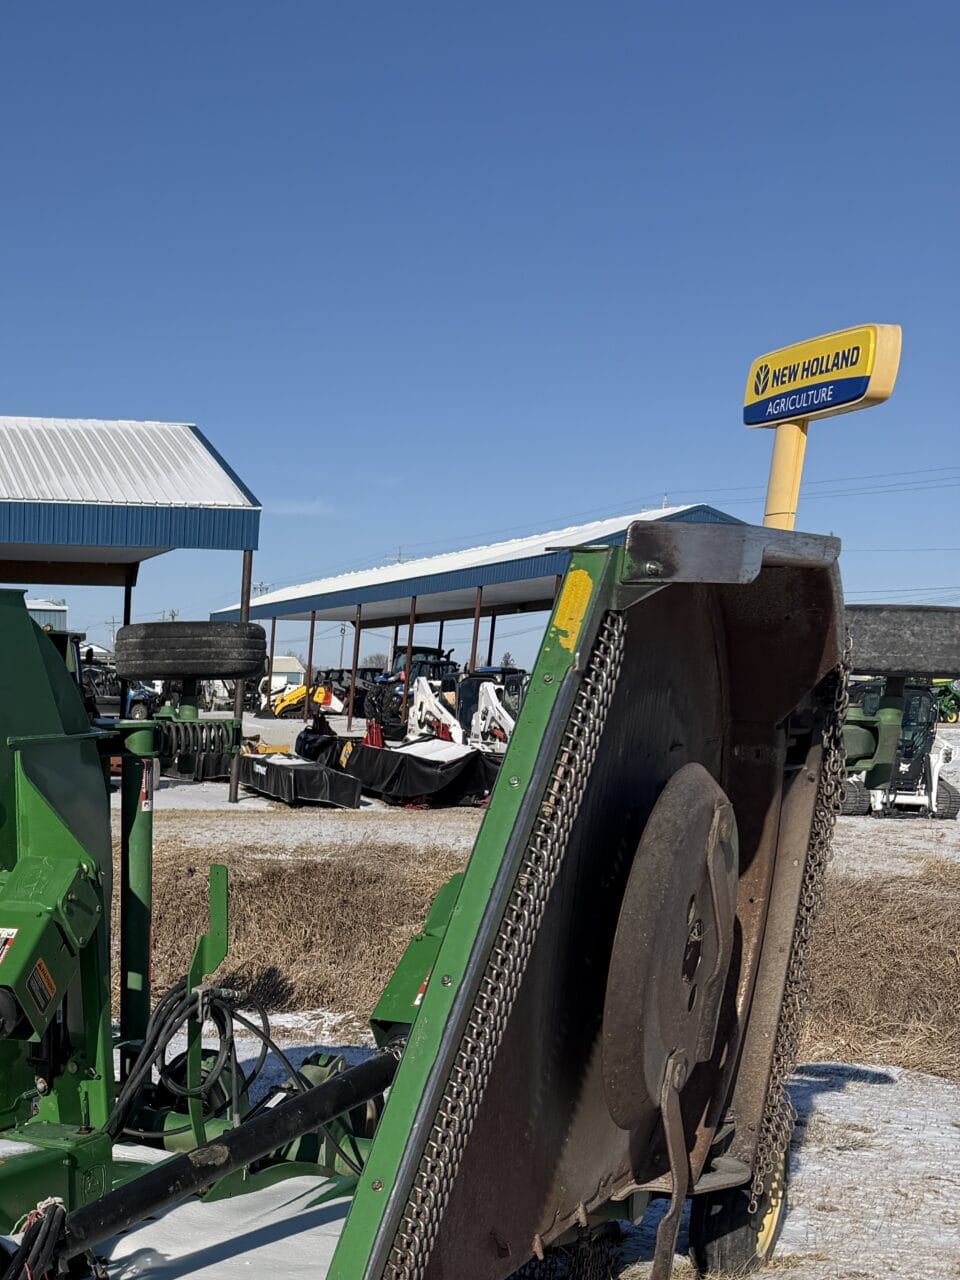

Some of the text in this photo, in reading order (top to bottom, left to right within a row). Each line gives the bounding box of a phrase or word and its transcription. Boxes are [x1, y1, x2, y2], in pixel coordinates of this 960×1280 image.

[771, 345, 861, 388] NEW HOLLAND
[765, 385, 835, 416] AGRICULTURE
